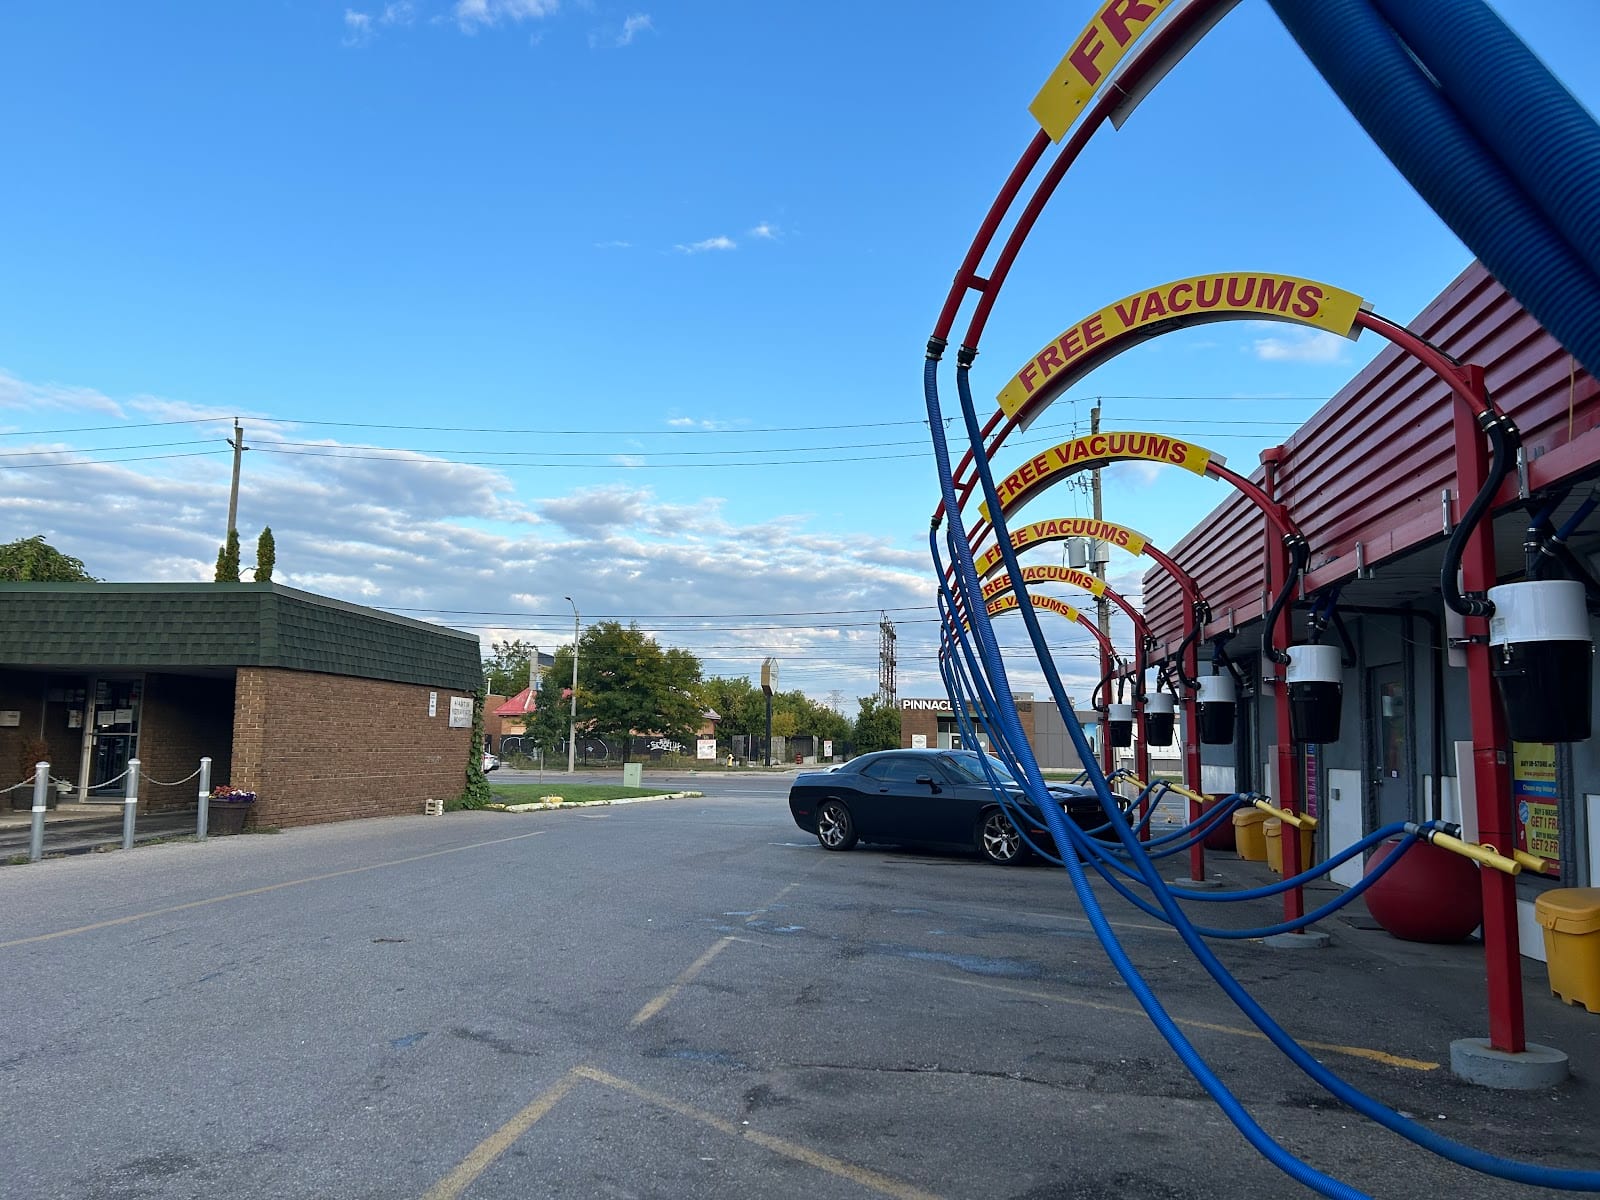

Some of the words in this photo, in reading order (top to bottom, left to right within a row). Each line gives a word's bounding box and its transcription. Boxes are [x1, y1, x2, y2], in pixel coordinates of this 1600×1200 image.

[1069, 0, 1164, 87] FR
[1017, 314, 1106, 394] FREE
[1113, 277, 1323, 328] VACUUMS
[996, 454, 1050, 506] FREE
[1054, 434, 1188, 465] VACUUMS
[1032, 519, 1130, 546] VACUUMS
[982, 574, 1012, 597] REE
[1005, 595, 1069, 616] VUUMS
[1531, 815, 1543, 828] GET
[1531, 838, 1543, 851] GET
[1544, 840, 1548, 852] 2
